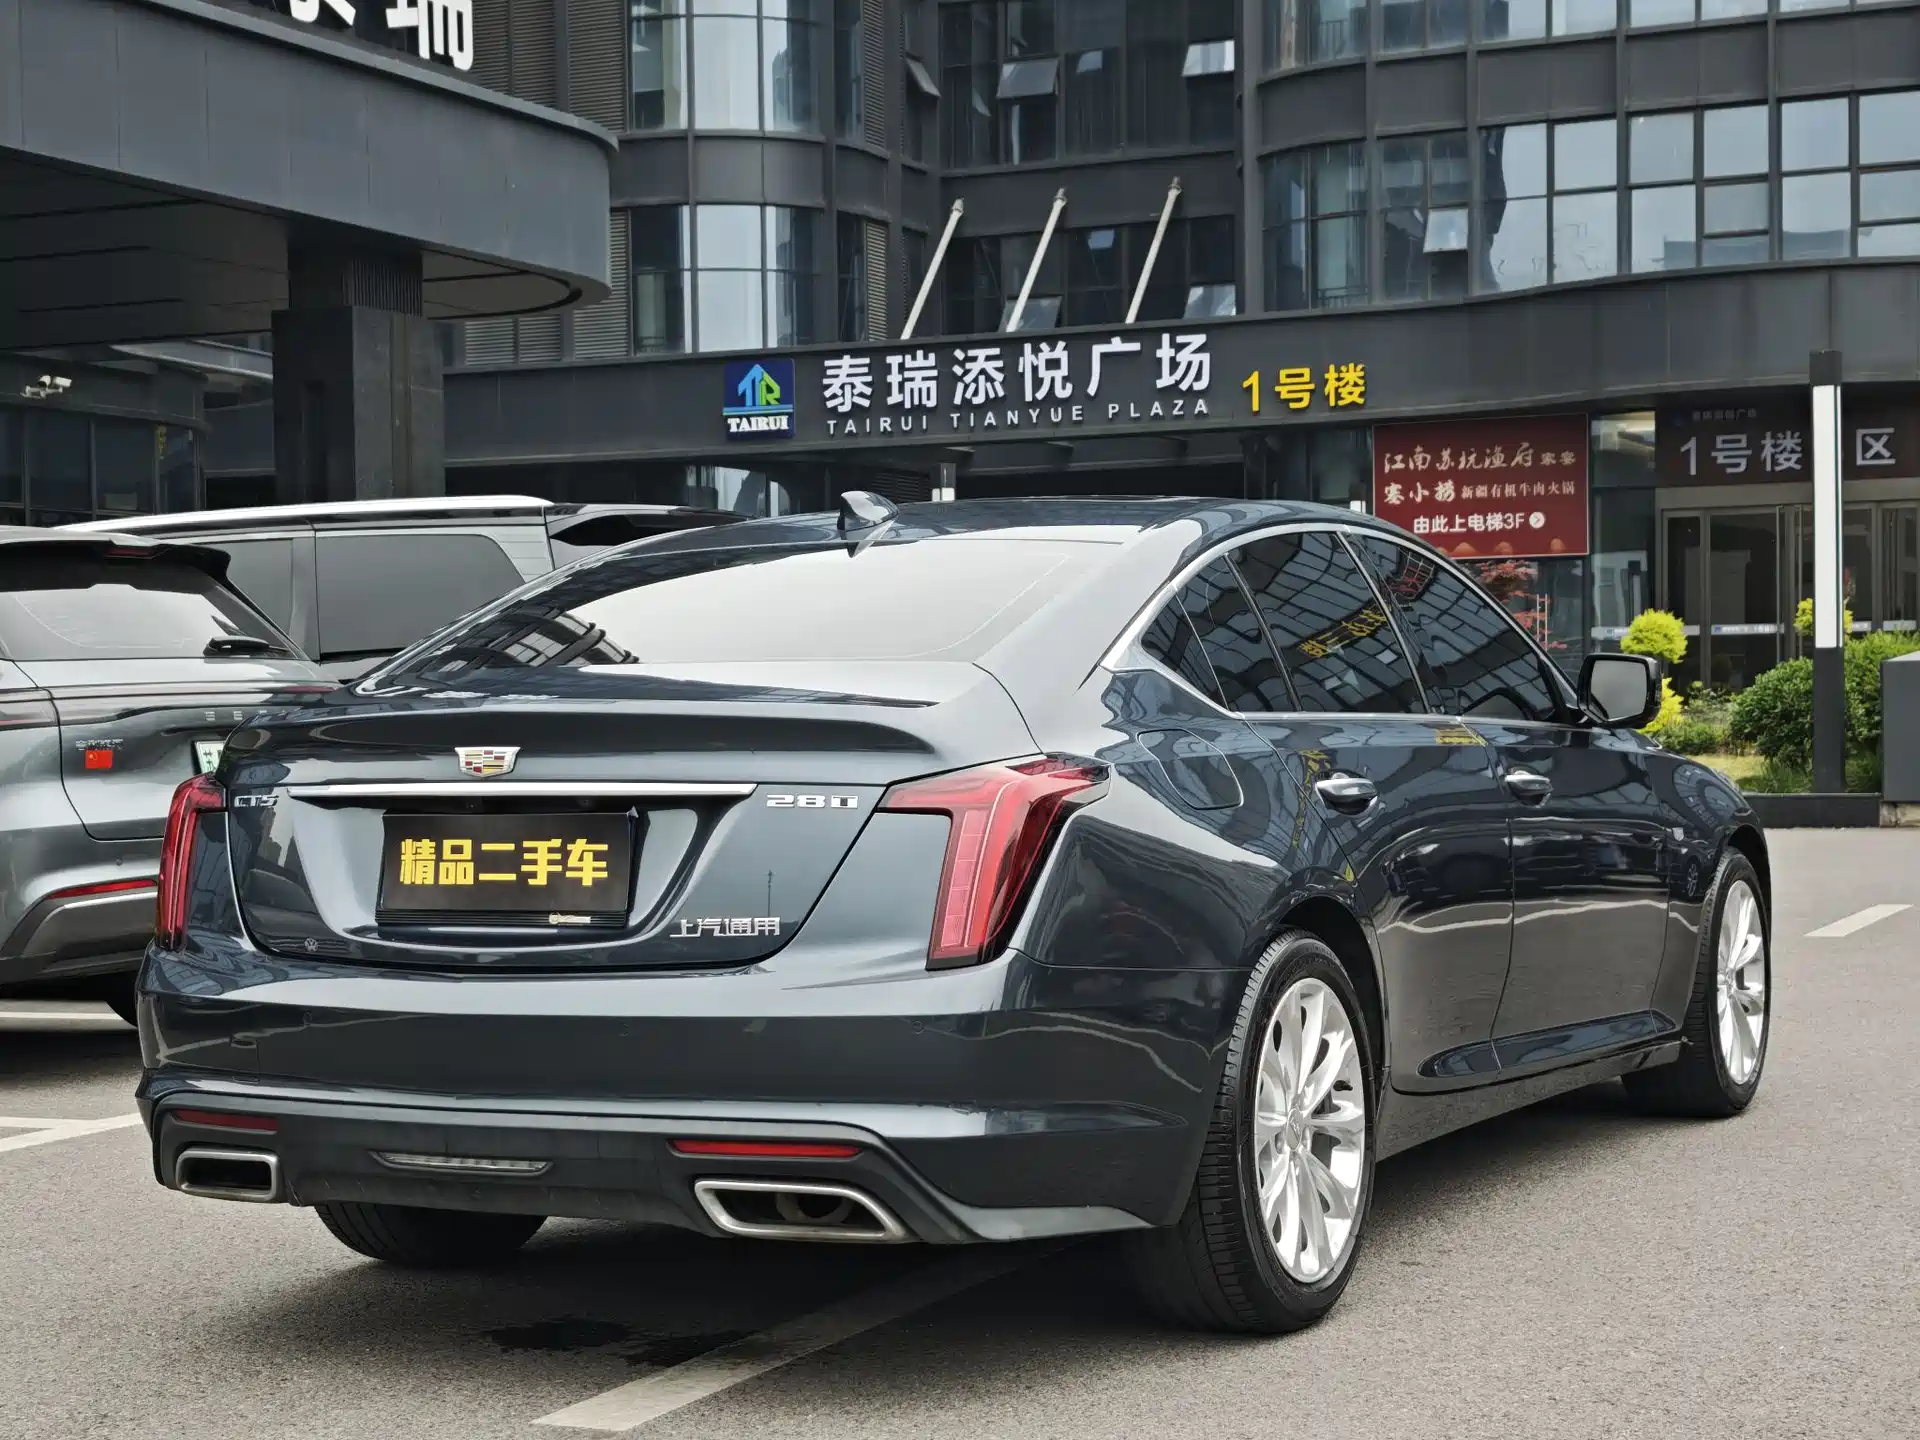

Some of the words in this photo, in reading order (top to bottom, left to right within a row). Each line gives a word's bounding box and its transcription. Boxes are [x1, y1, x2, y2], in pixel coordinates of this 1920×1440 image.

[822, 333, 1211, 412] 泰瑞添悦广场
[1242, 362, 1366, 412] 1号楼
[727, 415, 789, 433] TAIRUI
[827, 415, 927, 435] TAIRUI
[950, 405, 1084, 429] TIANYUE
[1108, 399, 1208, 419] PLAZA
[1413, 512, 1525, 533] 由此上电梯3F
[766, 794, 859, 808] 28T
[400, 839, 609, 886] 精品二手车
[670, 917, 781, 938] 上汽通用
